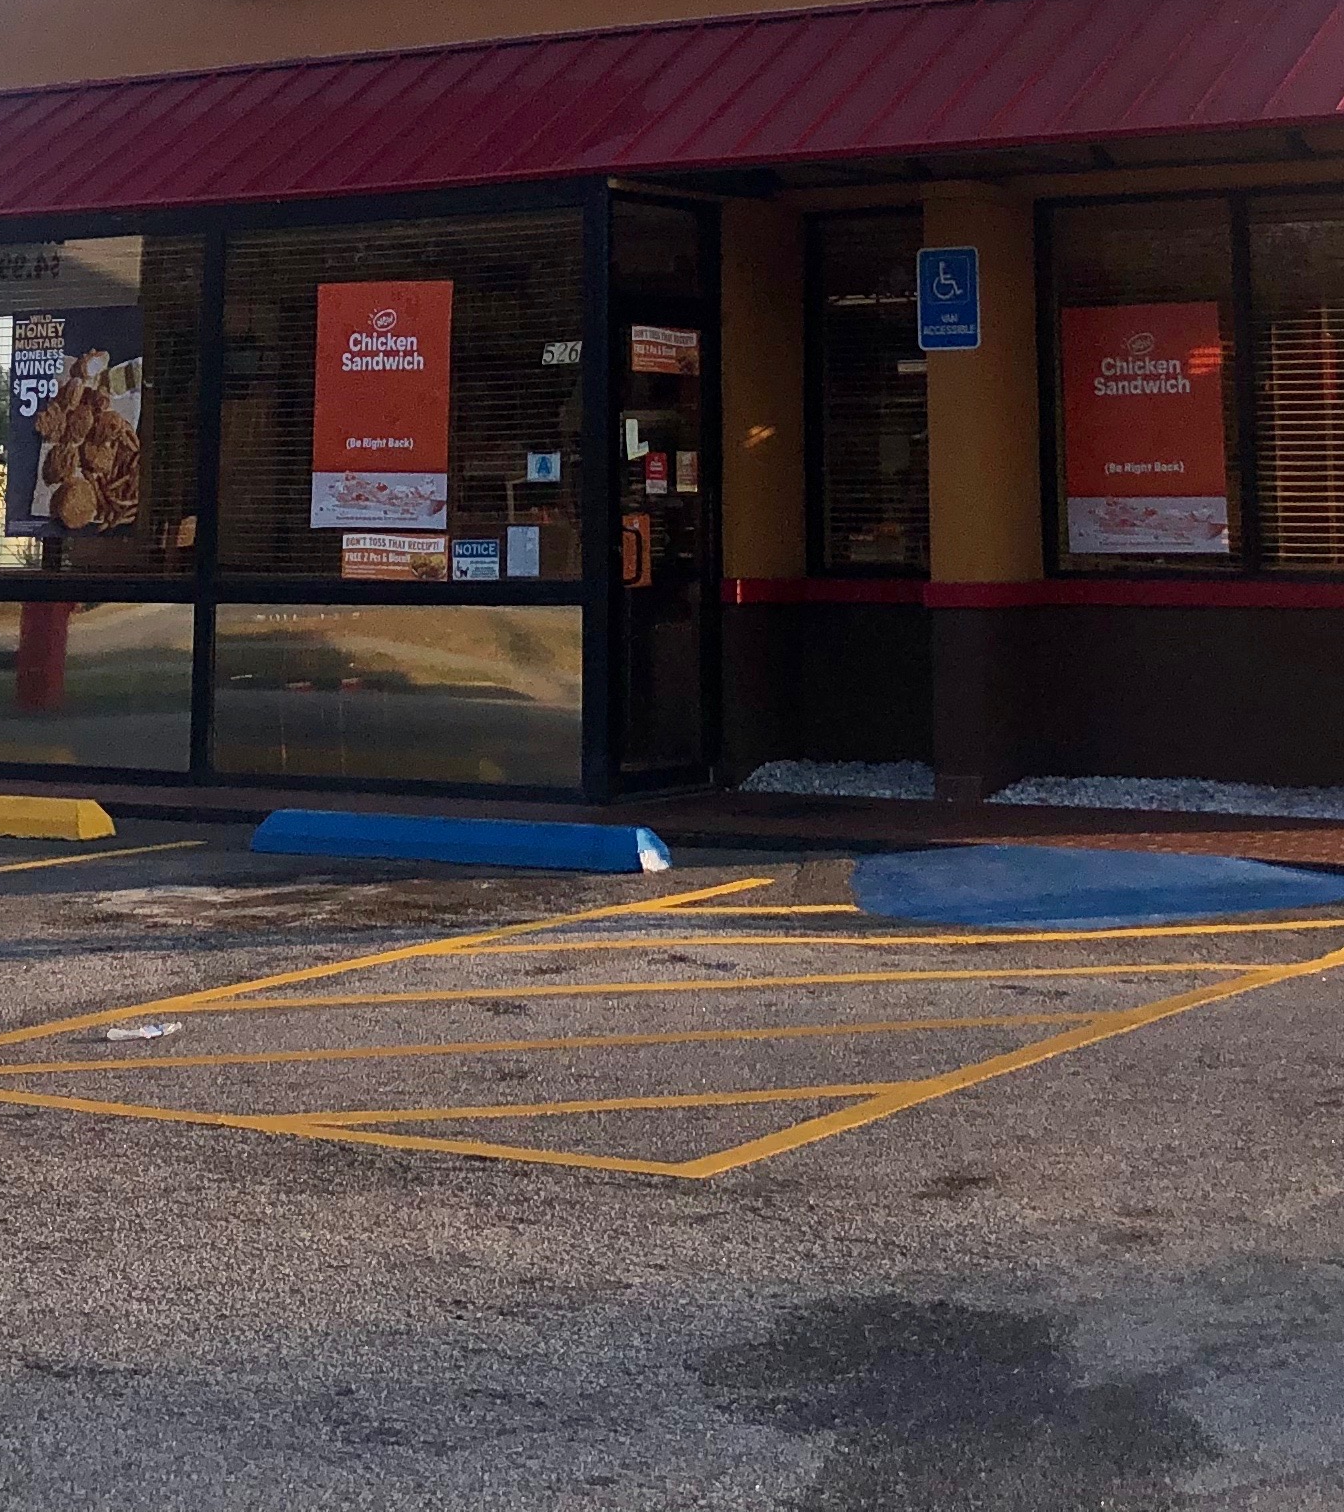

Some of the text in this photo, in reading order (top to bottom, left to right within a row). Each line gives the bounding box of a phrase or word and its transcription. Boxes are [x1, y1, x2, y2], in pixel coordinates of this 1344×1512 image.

[15, 322, 65, 339] HONEY
[14, 338, 65, 351] MUSTARD
[349, 332, 418, 352] Chicken
[15, 349, 65, 361] BONELESS
[542, 341, 579, 364] 526
[14, 359, 64, 376] WINGS
[341, 352, 424, 372] Sandwich
[1101, 356, 1181, 376] Chicken
[1094, 375, 1191, 396] Sandwich
[455, 543, 497, 556] NOTICE
